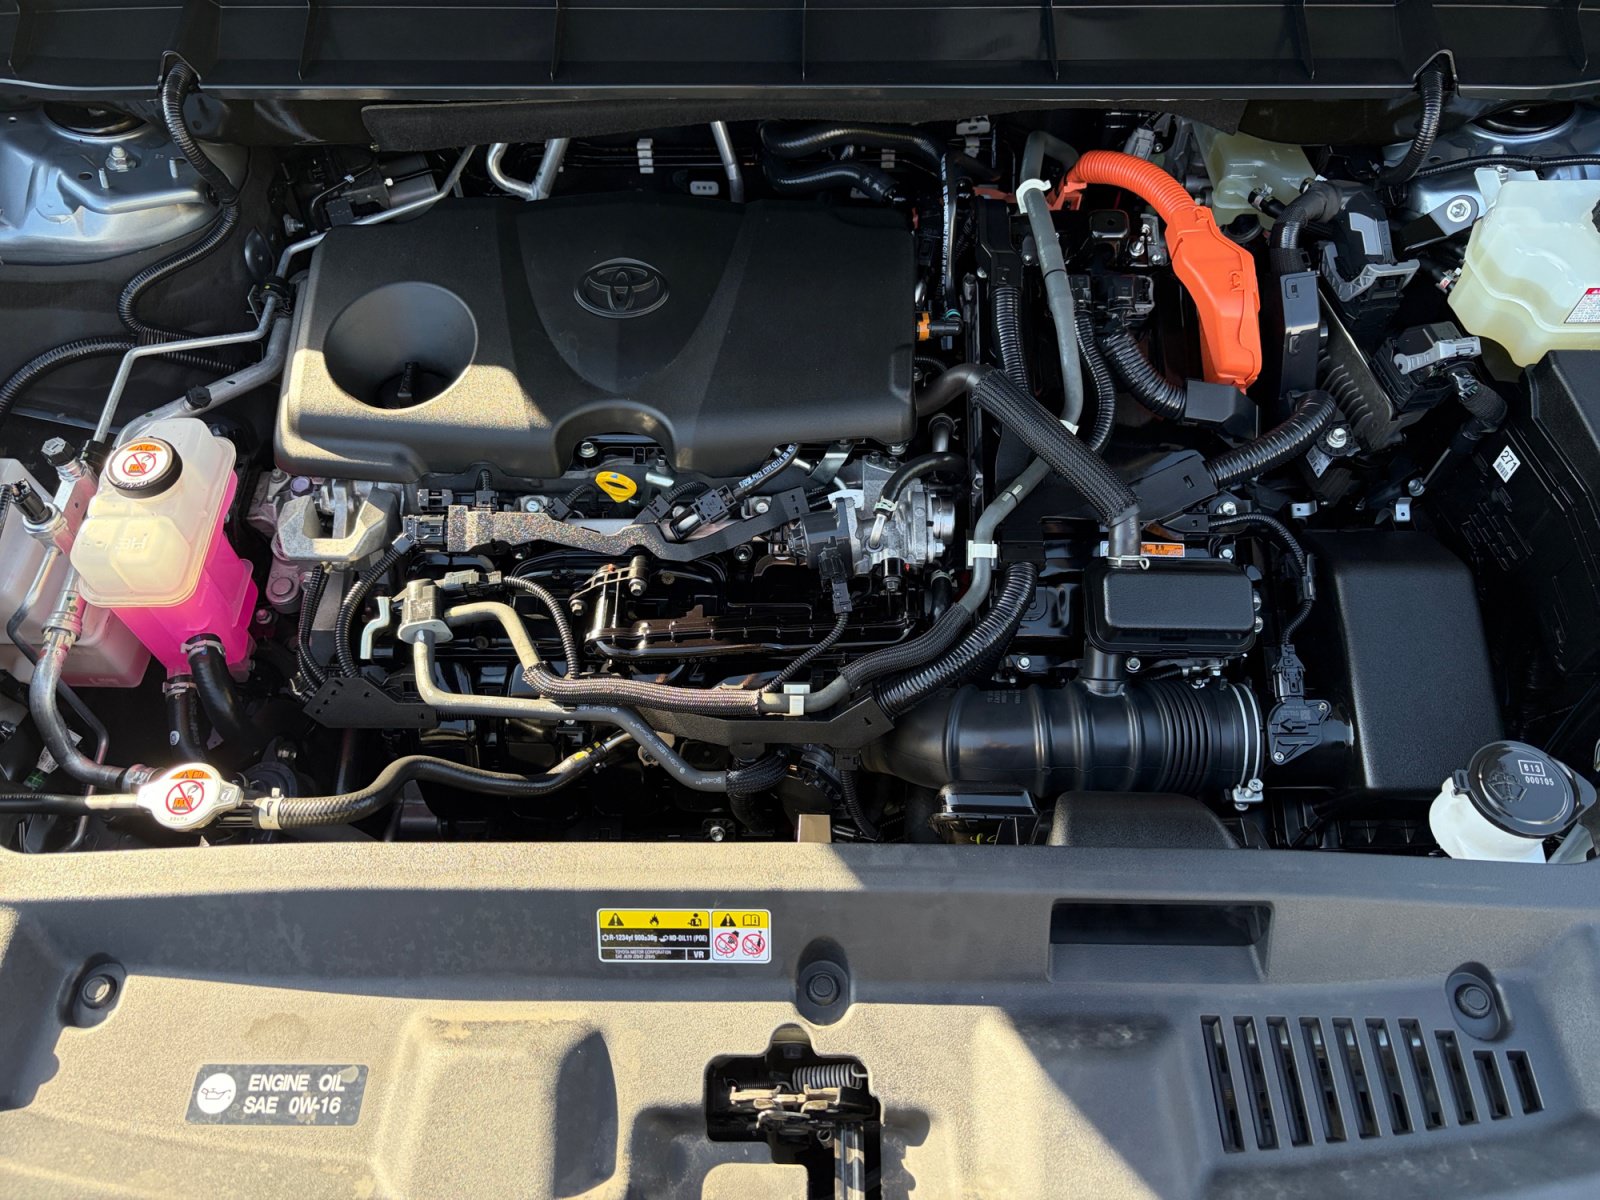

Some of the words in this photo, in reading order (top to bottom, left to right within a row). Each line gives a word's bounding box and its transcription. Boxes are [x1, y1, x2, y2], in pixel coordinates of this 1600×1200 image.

[1500, 450, 1518, 472] 271
[1523, 763, 1541, 773] e13
[1525, 776, 1554, 786] 000105
[248, 1074, 310, 1091] ENGINE
[319, 1074, 345, 1091] OIL
[243, 1096, 279, 1114] SAE
[288, 1096, 341, 1114] 0W-16
